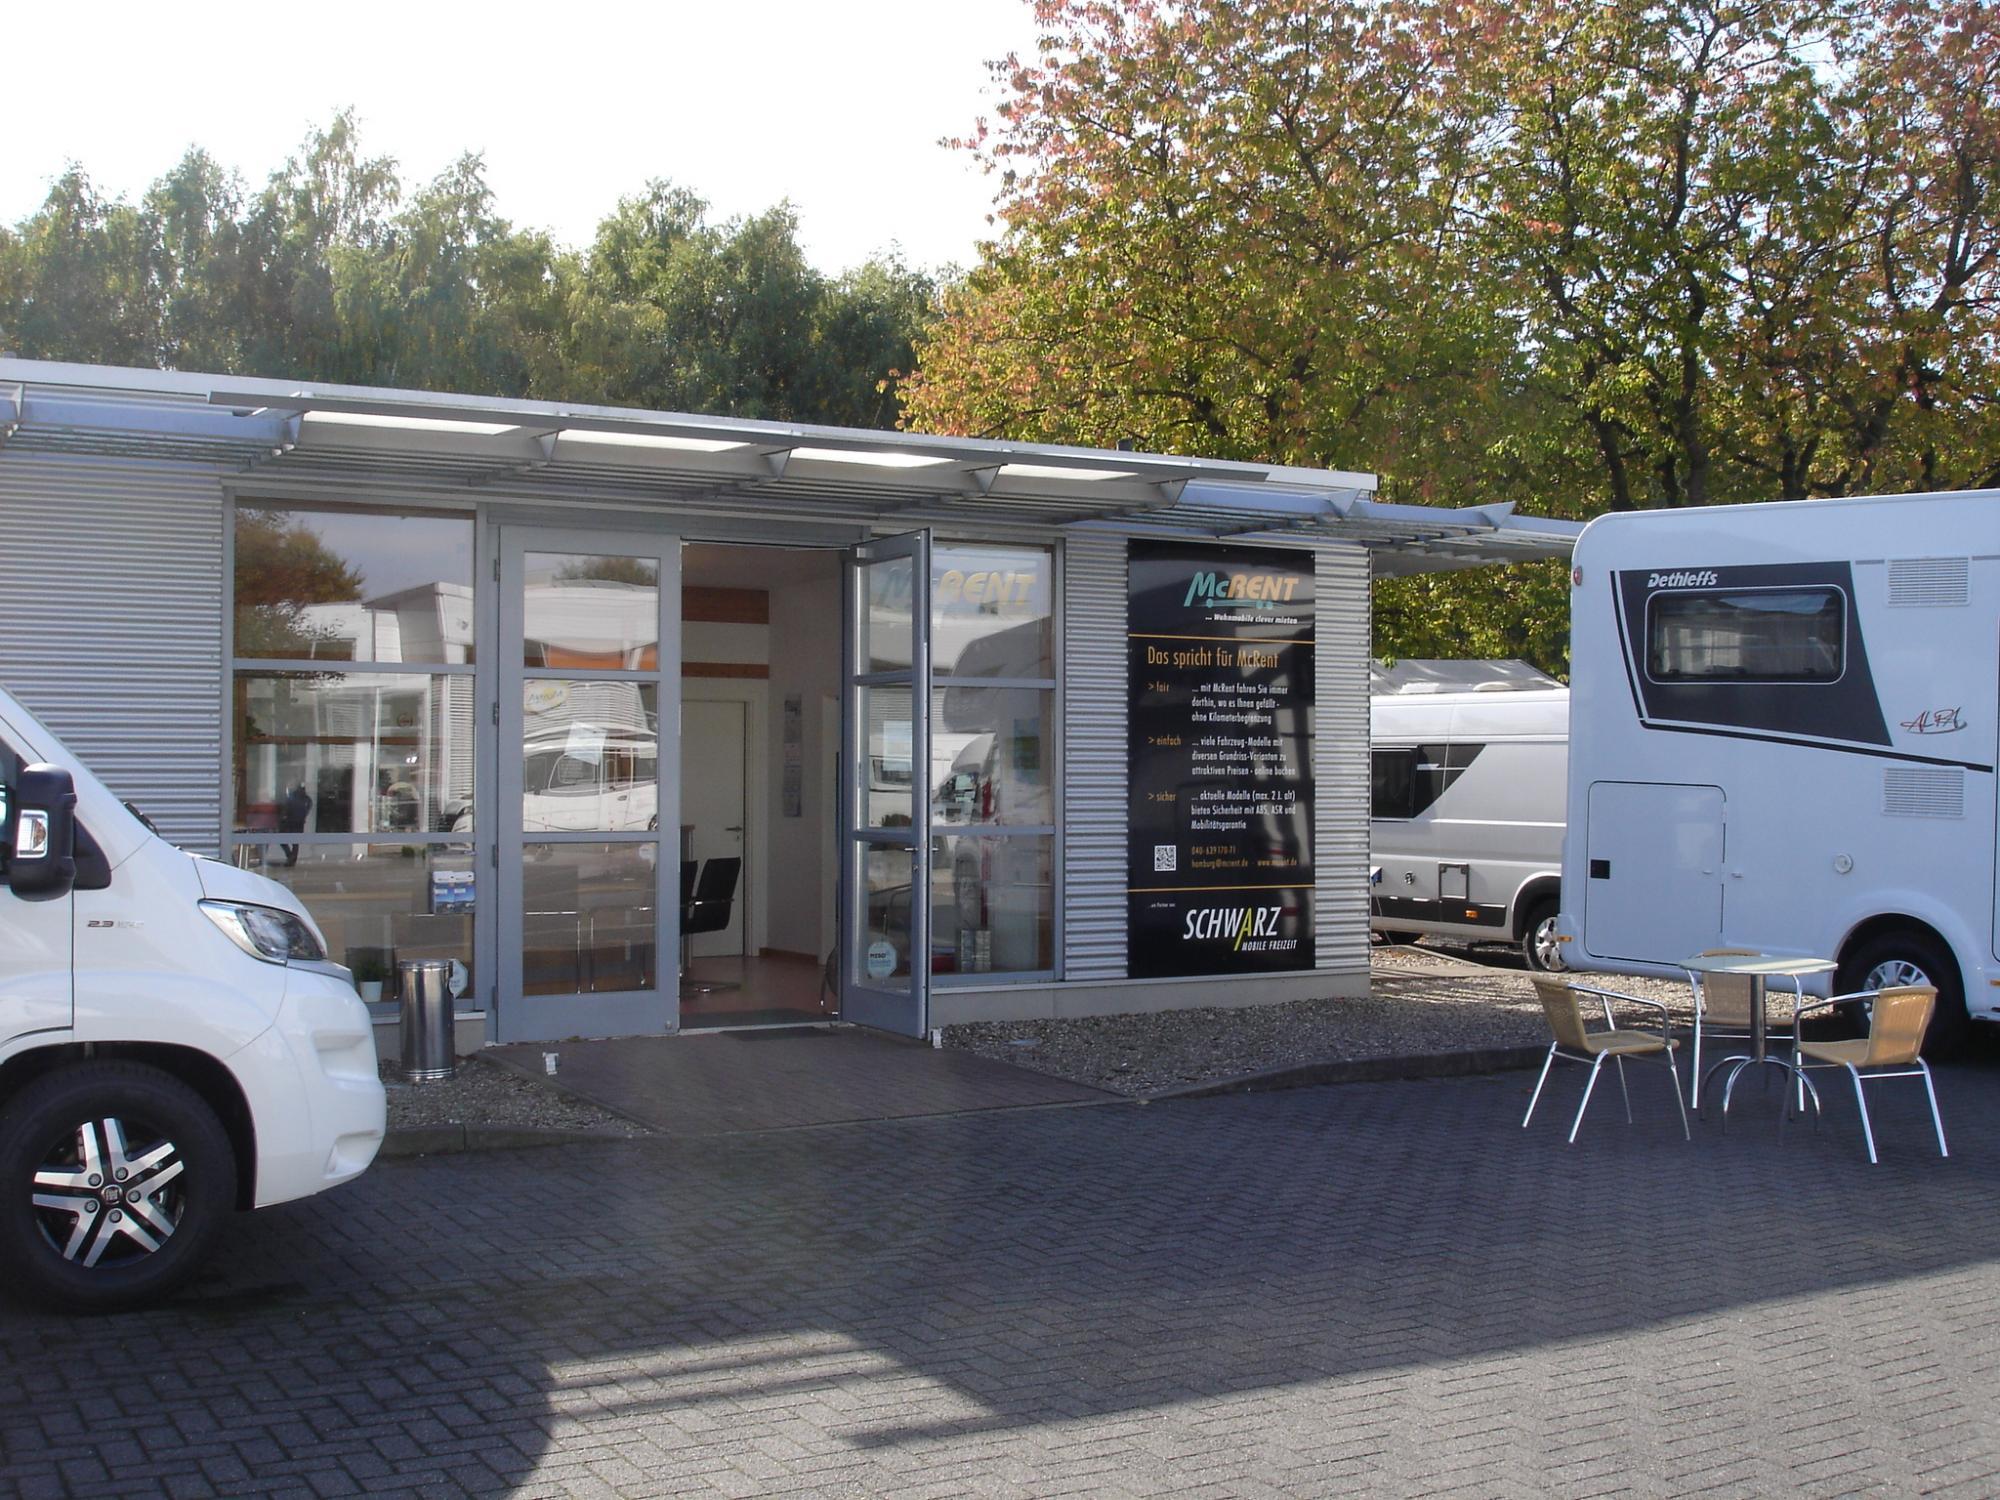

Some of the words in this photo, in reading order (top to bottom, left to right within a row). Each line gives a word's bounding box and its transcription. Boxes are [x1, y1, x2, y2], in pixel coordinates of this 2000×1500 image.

[1647, 570, 1718, 588] Dethleffs
[879, 566, 1036, 606] MRENT
[1184, 571, 1299, 607] McRENT
[1214, 613, 1254, 622] Wohnmobile
[1255, 615, 1274, 623] clever
[1275, 616, 1298, 624] mieten
[1147, 646, 1169, 665] Das
[1173, 646, 1211, 670] spricht
[1216, 646, 1233, 667] für
[1237, 649, 1278, 669] McRent
[1156, 681, 1170, 692] fair
[1200, 683, 1211, 693] mit
[1213, 683, 1235, 693] McRent
[1236, 683, 1256, 694] fahren
[1258, 684, 1268, 694] Sie
[1269, 685, 1288, 694] immer
[1191, 697, 1216, 708] dorthin,
[1218, 699, 1227, 707] wo
[1228, 699, 1236, 708] es
[1237, 698, 1254, 708] Ihnen
[1256, 698, 1276, 710] gefällt
[1191, 711, 1207, 722] ohne
[1209, 712, 1272, 725] Kilometerbegrenzung
[1156, 735, 1182, 746] einfach
[1200, 736, 1216, 746] viele
[1217, 736, 1272, 748] Fahrzeug-Modelle
[1273, 737, 1283, 747] mit
[1191, 750, 1217, 761] diversen
[1219, 750, 1278, 761] Grundriss-Varianten
[1279, 753, 1287, 761] zu
[1191, 764, 1226, 775] attraktiven
[1227, 765, 1249, 775] Preisen
[1254, 765, 1273, 775] online
[1274, 765, 1296, 775] buchen
[1156, 790, 1177, 802] sicher
[1200, 790, 1225, 800] aktuelle
[1226, 790, 1251, 800] Modelle
[1252, 790, 1269, 802] (max.
[1271, 790, 1276, 800] 2
[1284, 790, 1296, 802] alt)
[1191, 804, 1211, 815] bieten
[1212, 804, 1243, 815] Sicherheit
[1244, 805, 1254, 815] mit
[1255, 804, 1270, 816] ABS,
[1271, 804, 1283, 815] ASR
[1284, 803, 1296, 814] und
[1191, 819, 1247, 831] Mobilitätsgarantie
[1183, 907, 1282, 951] SCHWARZ
[1241, 940, 1267, 951] MOBILE
[1268, 939, 1298, 950] FREIZEIT
